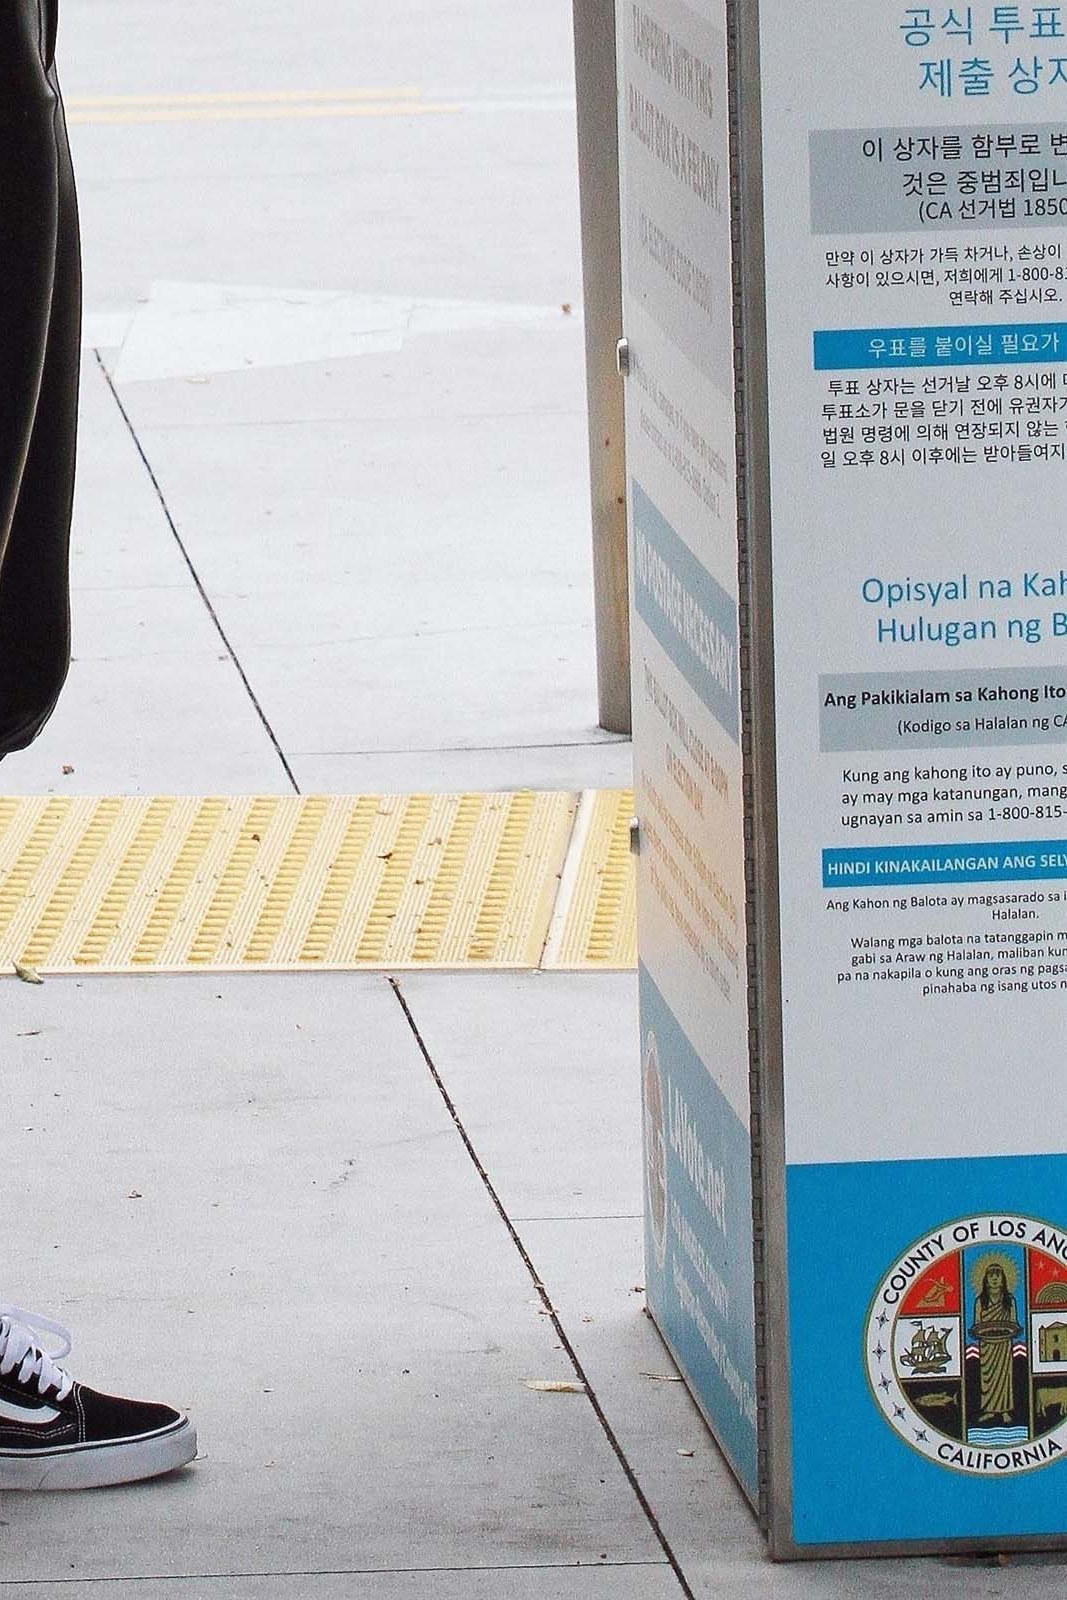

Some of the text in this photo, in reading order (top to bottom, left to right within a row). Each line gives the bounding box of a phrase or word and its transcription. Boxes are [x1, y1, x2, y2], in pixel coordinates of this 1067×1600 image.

[900, 6, 1065, 46] 공식 투표
[919, 57, 994, 97] 제출
[862, 138, 883, 162] 이
[893, 136, 963, 161] 상자를
[971, 133, 1041, 159] 함부로
[903, 171, 948, 197] 것은
[918, 200, 953, 223] (CA
[958, 198, 1015, 220] 선거법
[825, 243, 1062, 267] 만약 이 상자가 가득 차거나, 손상이
[825, 271, 869, 289] 사항이
[876, 270, 940, 287] 있으시면,
[944, 267, 1003, 284] 저희에게
[949, 288, 1063, 307] 연락해 주십시오.
[868, 332, 1060, 359] 우표를 붙이실 필요가
[827, 372, 1057, 397] 투표 상자는 선거날 오후 8시에
[821, 402, 888, 421] 투표소가
[894, 400, 925, 418] 문을
[932, 399, 964, 416] 닫기
[970, 398, 1002, 415] 전에
[822, 420, 1058, 445] 법원 명령에 의해 연장되지 않는
[821, 443, 1066, 468] 일 오후 8시 이후에는 받아들여지
[862, 574, 967, 608] Opisyal
[979, 579, 1011, 599] na
[878, 616, 996, 647] Hulugan
[1008, 617, 1041, 643] ng
[824, 685, 1066, 709] Ang Pakikialam sa Kahong Ito
[898, 718, 951, 736] (Kodigo
[955, 720, 970, 731] sa
[975, 716, 1027, 730] Halalan
[1032, 717, 1049, 730] ng
[843, 769, 879, 784] Kung
[884, 770, 910, 783] ang
[914, 766, 968, 783] kahong
[972, 764, 991, 778] ito
[995, 767, 1012, 779] ay
[1016, 765, 1058, 779] puno,
[841, 785, 1067, 806] ay may mga katanungan, mang
[841, 813, 902, 828] ugnayan
[907, 812, 923, 824] sa
[927, 809, 963, 823] amin
[968, 810, 983, 821] sa
[828, 862, 871, 876] HINDI
[874, 857, 999, 873] KINAKAILANGAN
[1003, 855, 1035, 868] ANG
[827, 899, 849, 912] Ang
[853, 897, 889, 909] Kahon
[893, 898, 907, 909] ng
[910, 896, 947, 907] Balota
[951, 896, 964, 907] ay
[967, 891, 1044, 906] magsasarado
[1048, 892, 1060, 901] sa
[992, 909, 1039, 920] Halalan.
[851, 937, 894, 949] Walang
[898, 936, 923, 947] mga
[926, 933, 963, 945] balota
[967, 935, 981, 944] na
[984, 930, 1054, 945] tatanggapin
[851, 953, 876, 967] gabi
[880, 954, 892, 963] sa
[895, 952, 926, 962] Araw
[929, 952, 943, 964] ng
[947, 949, 994, 962] Halalan,
[998, 946, 1044, 959] maliban
[837, 972, 851, 984] pa
[855, 971, 869, 981] na
[873, 968, 921, 981] nakapila
[925, 969, 933, 978] o
[936, 965, 964, 979] kung
[967, 966, 989, 978] ang
[992, 966, 1017, 975] oras
[1020, 965, 1035, 976] ng
[923, 983, 977, 996] pinahaba
[980, 984, 994, 994] ng
[997, 980, 1029, 993] isang
[1031, 980, 1056, 991] utos
[667, 1074, 726, 1239] LAVote.net
[884, 1235, 945, 1305] COUNTY
[953, 1222, 980, 1243] OF
[989, 1220, 1027, 1238] LOS
[937, 1438, 1063, 1470] CALIFORNIA
